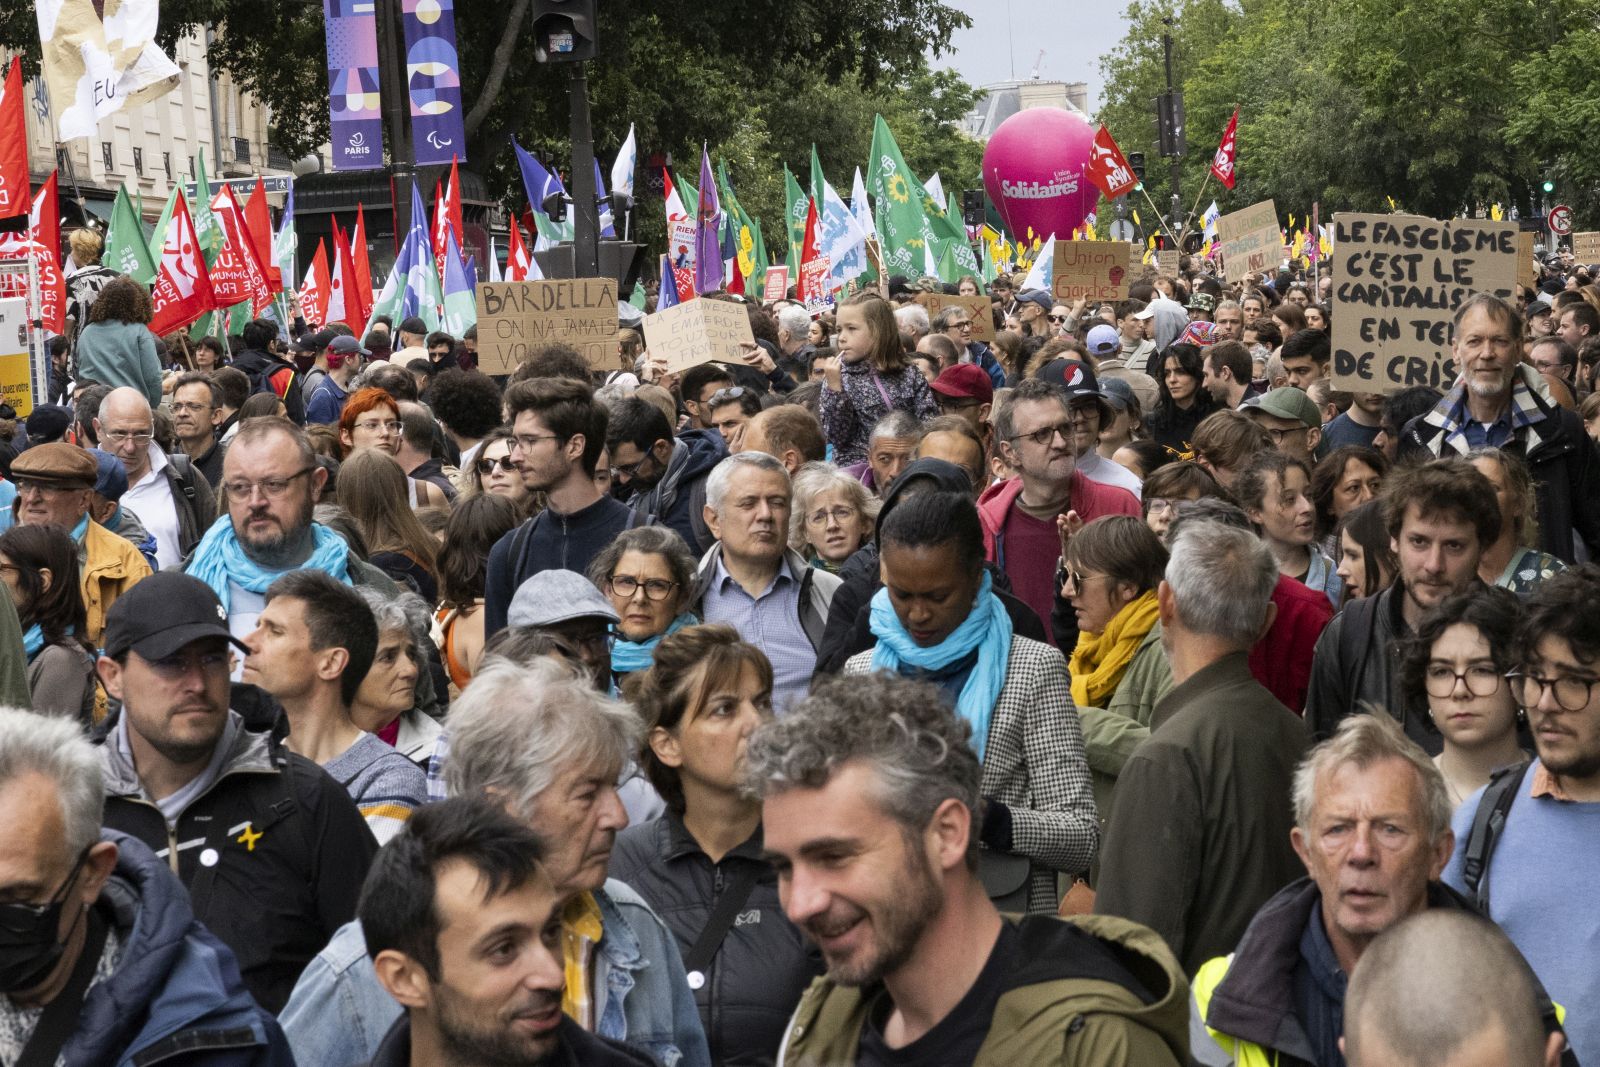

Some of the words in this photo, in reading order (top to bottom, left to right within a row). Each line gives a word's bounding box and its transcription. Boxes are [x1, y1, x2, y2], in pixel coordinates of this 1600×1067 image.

[345, 146, 370, 155] PARIS
[1053, 169, 1071, 179] Union
[1002, 180, 1078, 199] Solidaires
[1336, 221, 1367, 243] LE
[1063, 243, 1116, 266] Union
[1347, 250, 1423, 283] C'EST
[1434, 257, 1475, 286] LE
[483, 281, 616, 315] BARDELLA
[1055, 275, 1119, 299] Gauches
[646, 314, 665, 327] LA
[673, 301, 744, 318] JEUNESSE
[671, 315, 744, 334] EMMERDE
[496, 319, 525, 339] ON
[562, 318, 617, 337] JAMAIS
[1360, 317, 1400, 343] EN
[1409, 320, 1455, 347] TE
[680, 341, 720, 361] FRONT
[1334, 349, 1376, 380] DE
